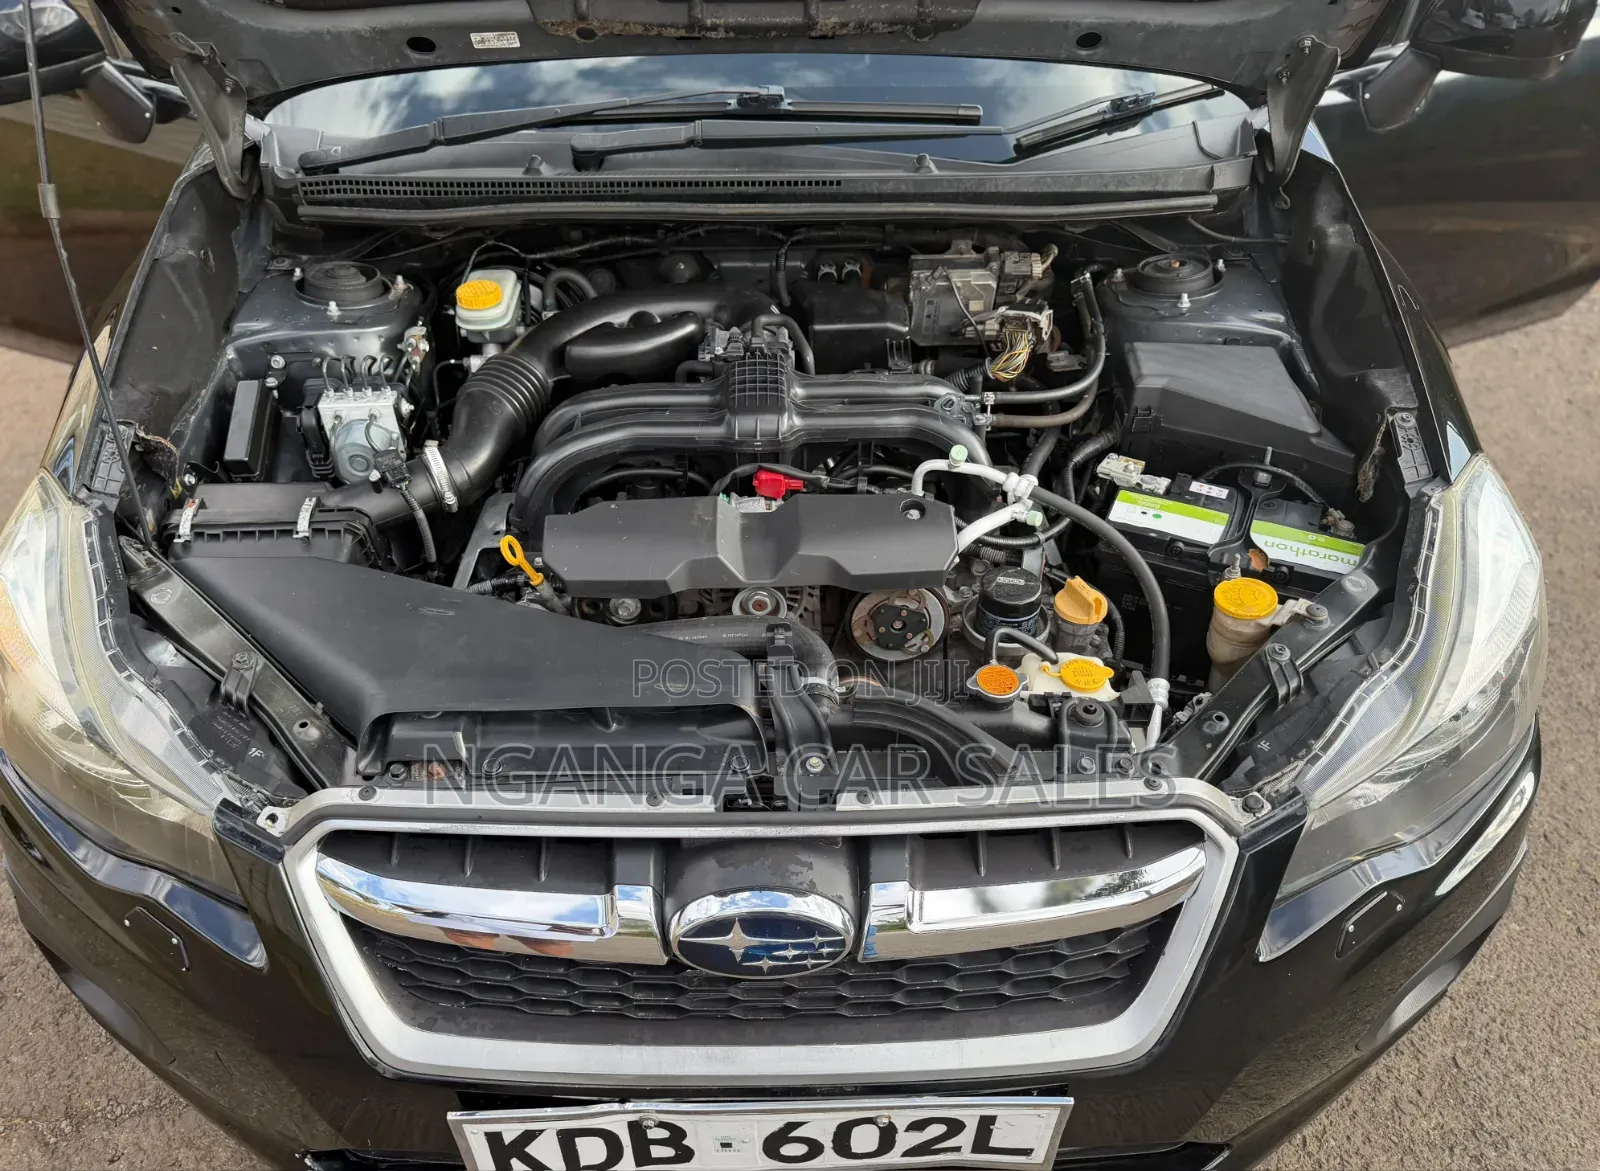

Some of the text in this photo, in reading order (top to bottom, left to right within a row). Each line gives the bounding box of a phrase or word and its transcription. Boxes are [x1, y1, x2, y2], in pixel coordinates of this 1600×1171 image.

[1264, 539, 1359, 567] marathon
[484, 1115, 1034, 1171] KDB 602L
